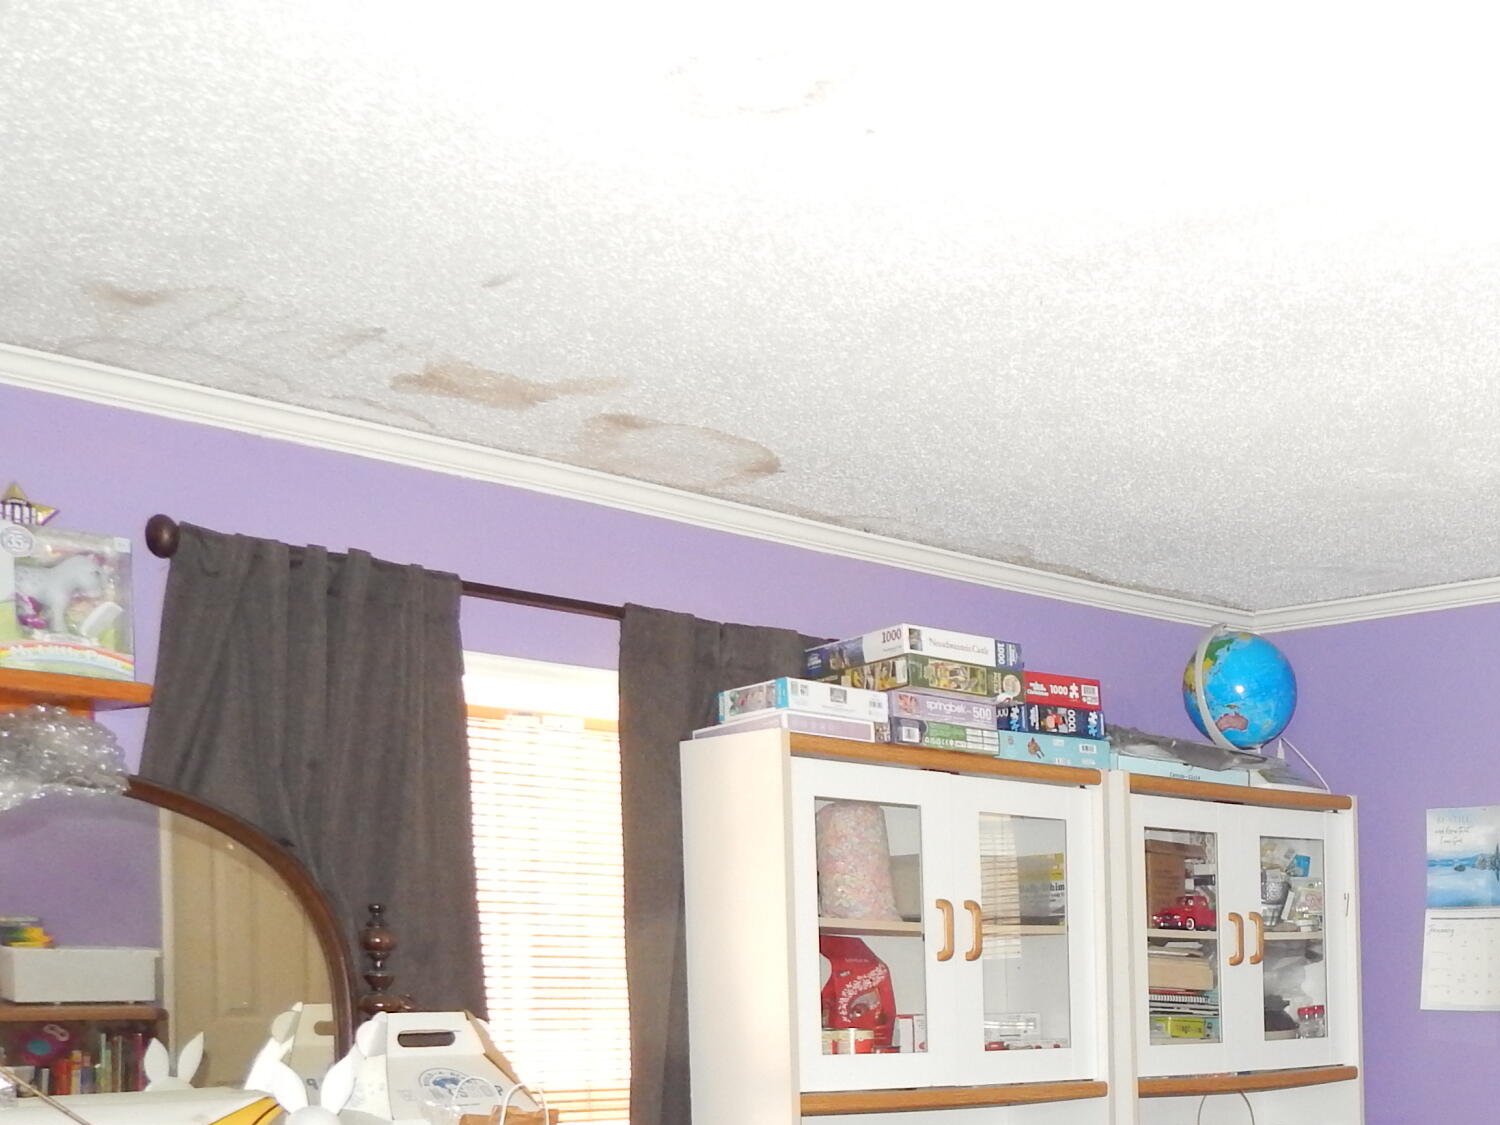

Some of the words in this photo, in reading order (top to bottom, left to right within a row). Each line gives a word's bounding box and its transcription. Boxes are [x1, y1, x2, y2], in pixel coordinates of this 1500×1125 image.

[882, 628, 902, 643] 1000
[998, 642, 1006, 665] 1000
[1049, 684, 1069, 696] 1000
[972, 705, 992, 720] 500
